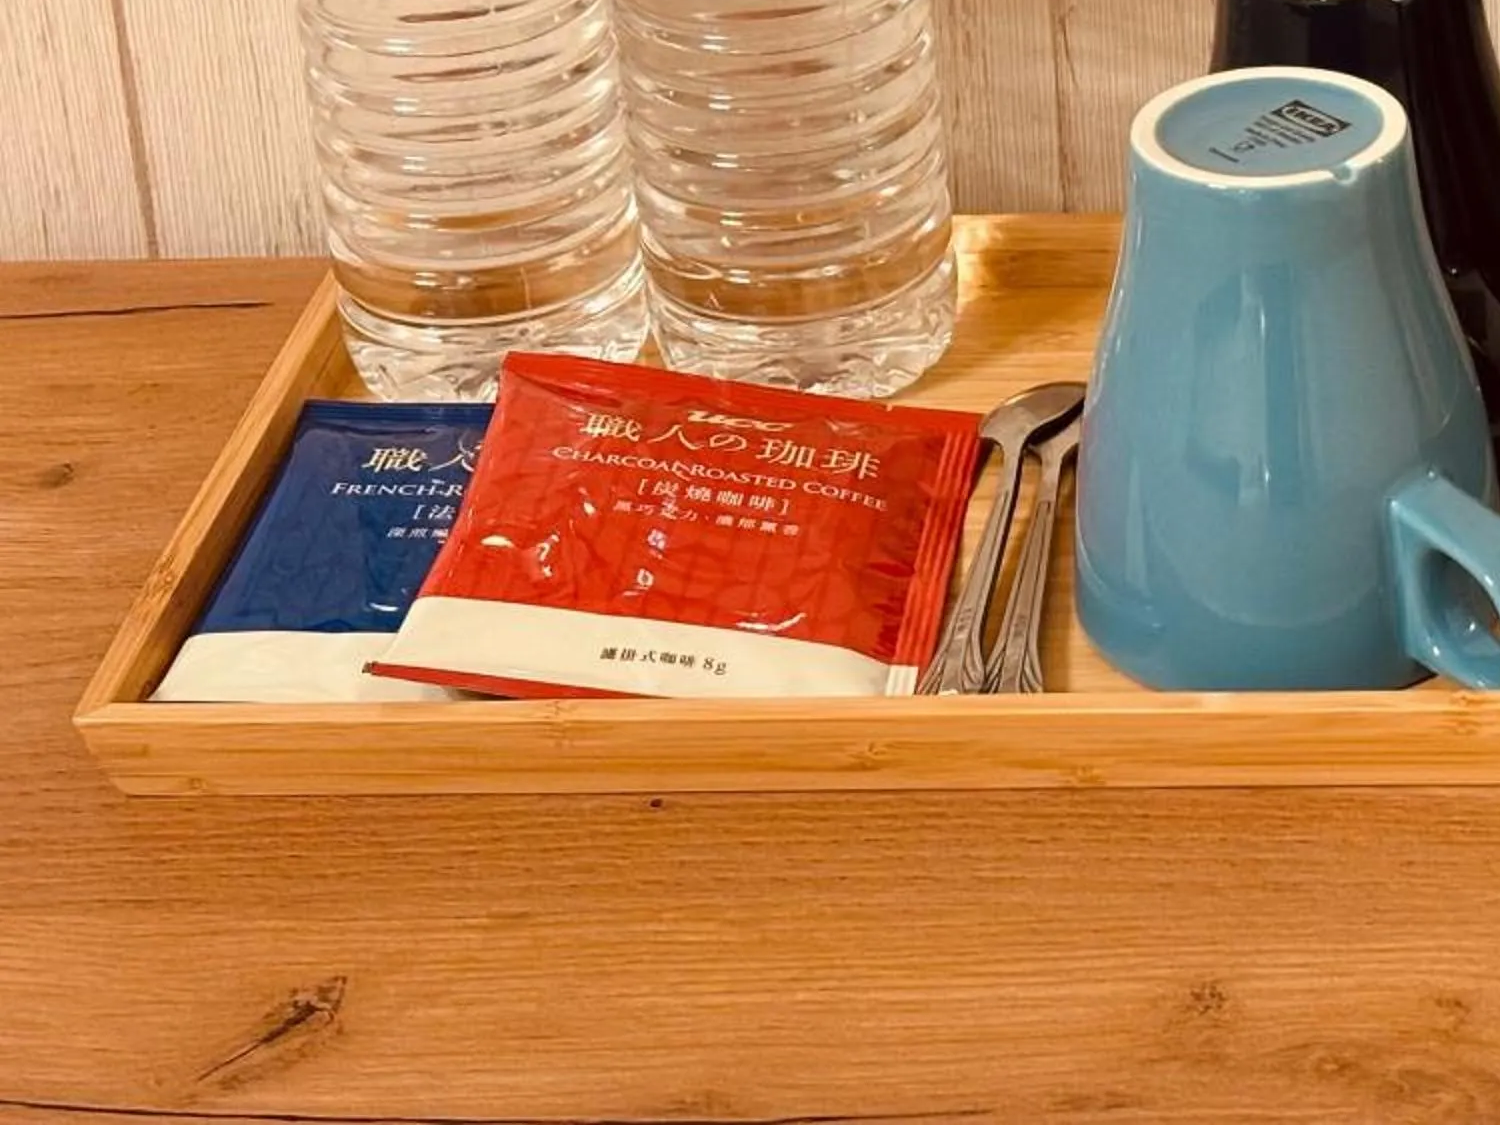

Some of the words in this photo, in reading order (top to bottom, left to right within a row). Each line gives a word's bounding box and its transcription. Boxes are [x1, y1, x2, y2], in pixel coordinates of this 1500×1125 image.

[579, 413, 882, 480] 職人の珈琲
[803, 480, 889, 511] COFFEE
[702, 656, 727, 676] 8g
